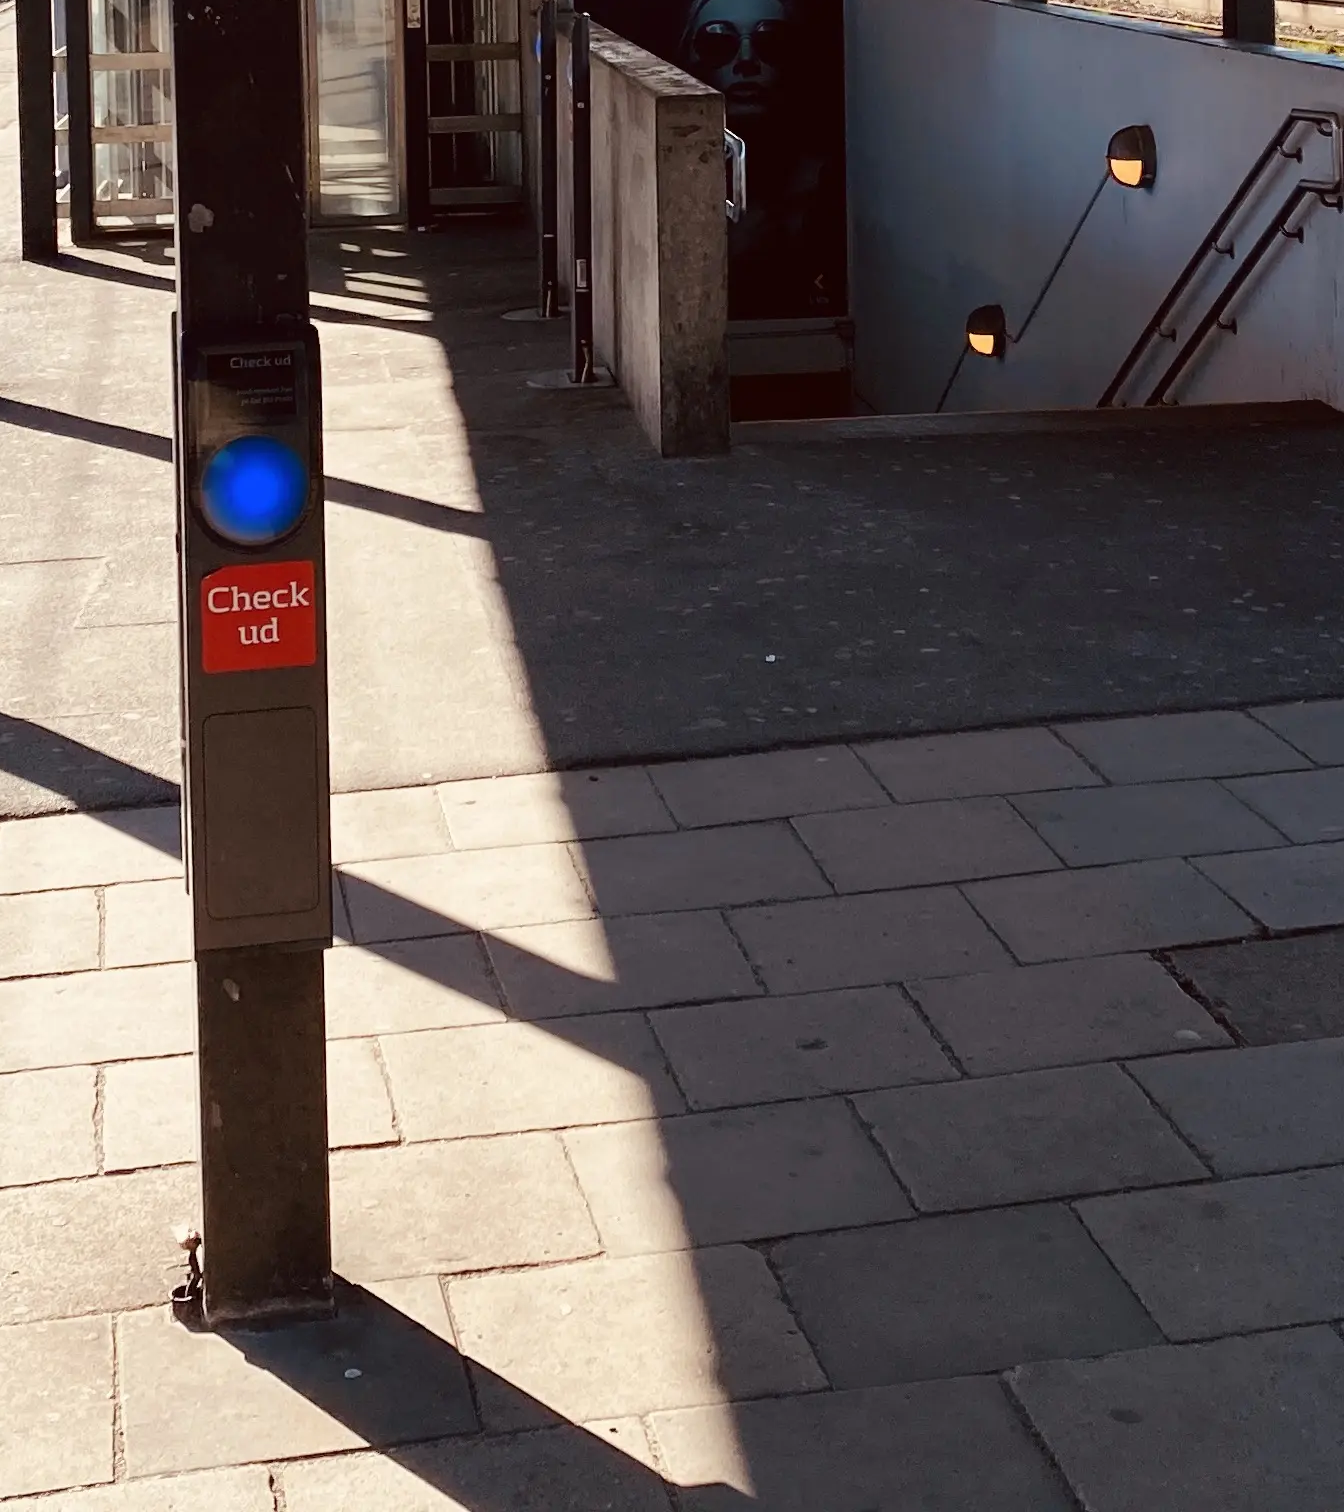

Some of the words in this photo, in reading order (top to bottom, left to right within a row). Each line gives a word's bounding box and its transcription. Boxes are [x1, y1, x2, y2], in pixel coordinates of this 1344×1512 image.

[230, 355, 272, 369] Check
[274, 354, 292, 366] ud
[207, 581, 310, 614] Check
[238, 617, 280, 645] ud
